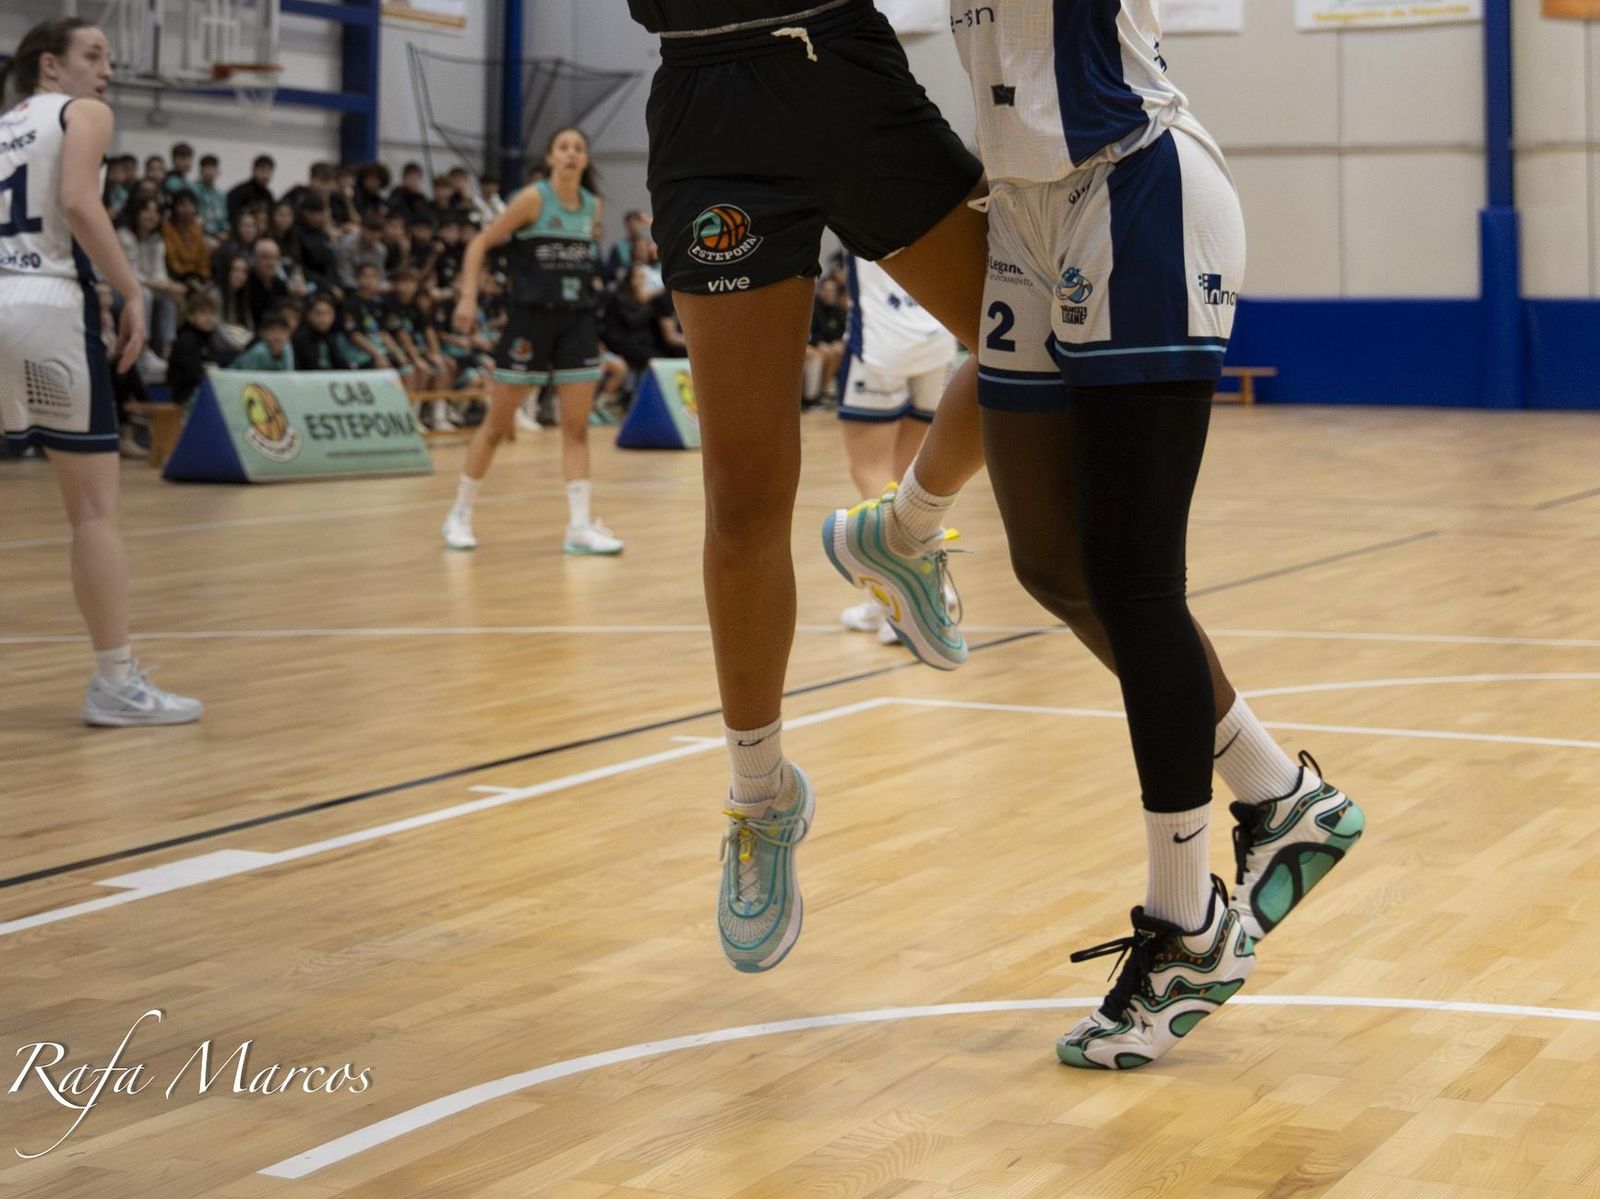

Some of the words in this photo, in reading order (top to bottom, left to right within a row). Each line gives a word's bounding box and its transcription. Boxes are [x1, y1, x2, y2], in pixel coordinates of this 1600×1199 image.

[692, 237, 757, 261] ESTEPONA
[708, 276, 751, 292] vive
[986, 301, 1016, 352] 2
[328, 381, 375, 405] CAB
[304, 412, 415, 441] ESTEPONA
